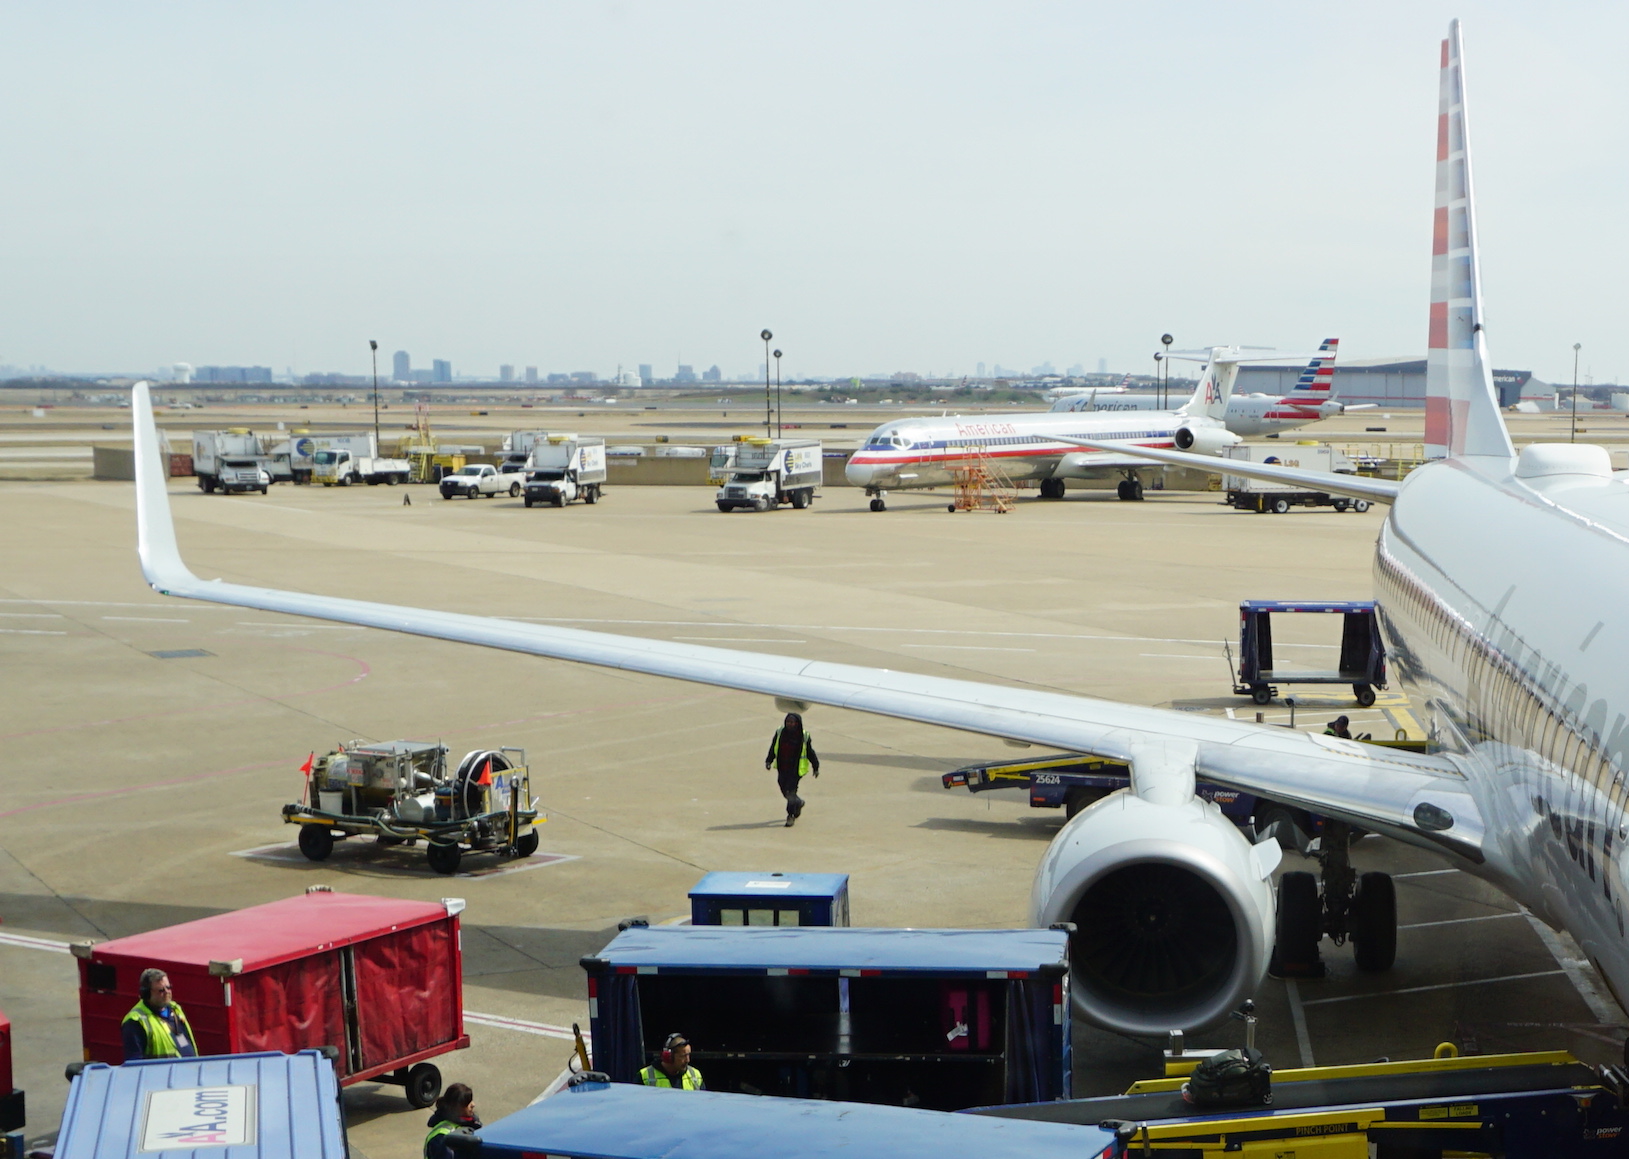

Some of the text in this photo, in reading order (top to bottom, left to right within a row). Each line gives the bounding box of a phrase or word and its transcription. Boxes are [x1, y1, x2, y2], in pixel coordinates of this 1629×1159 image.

[955, 422, 1017, 437] American
[1035, 774, 1061, 785] 25624
[1213, 790, 1240, 800] power
[177, 1090, 228, 1144] AA.com
[1295, 1123, 1349, 1136] PINCH POINT
[1596, 1125, 1623, 1136] power
